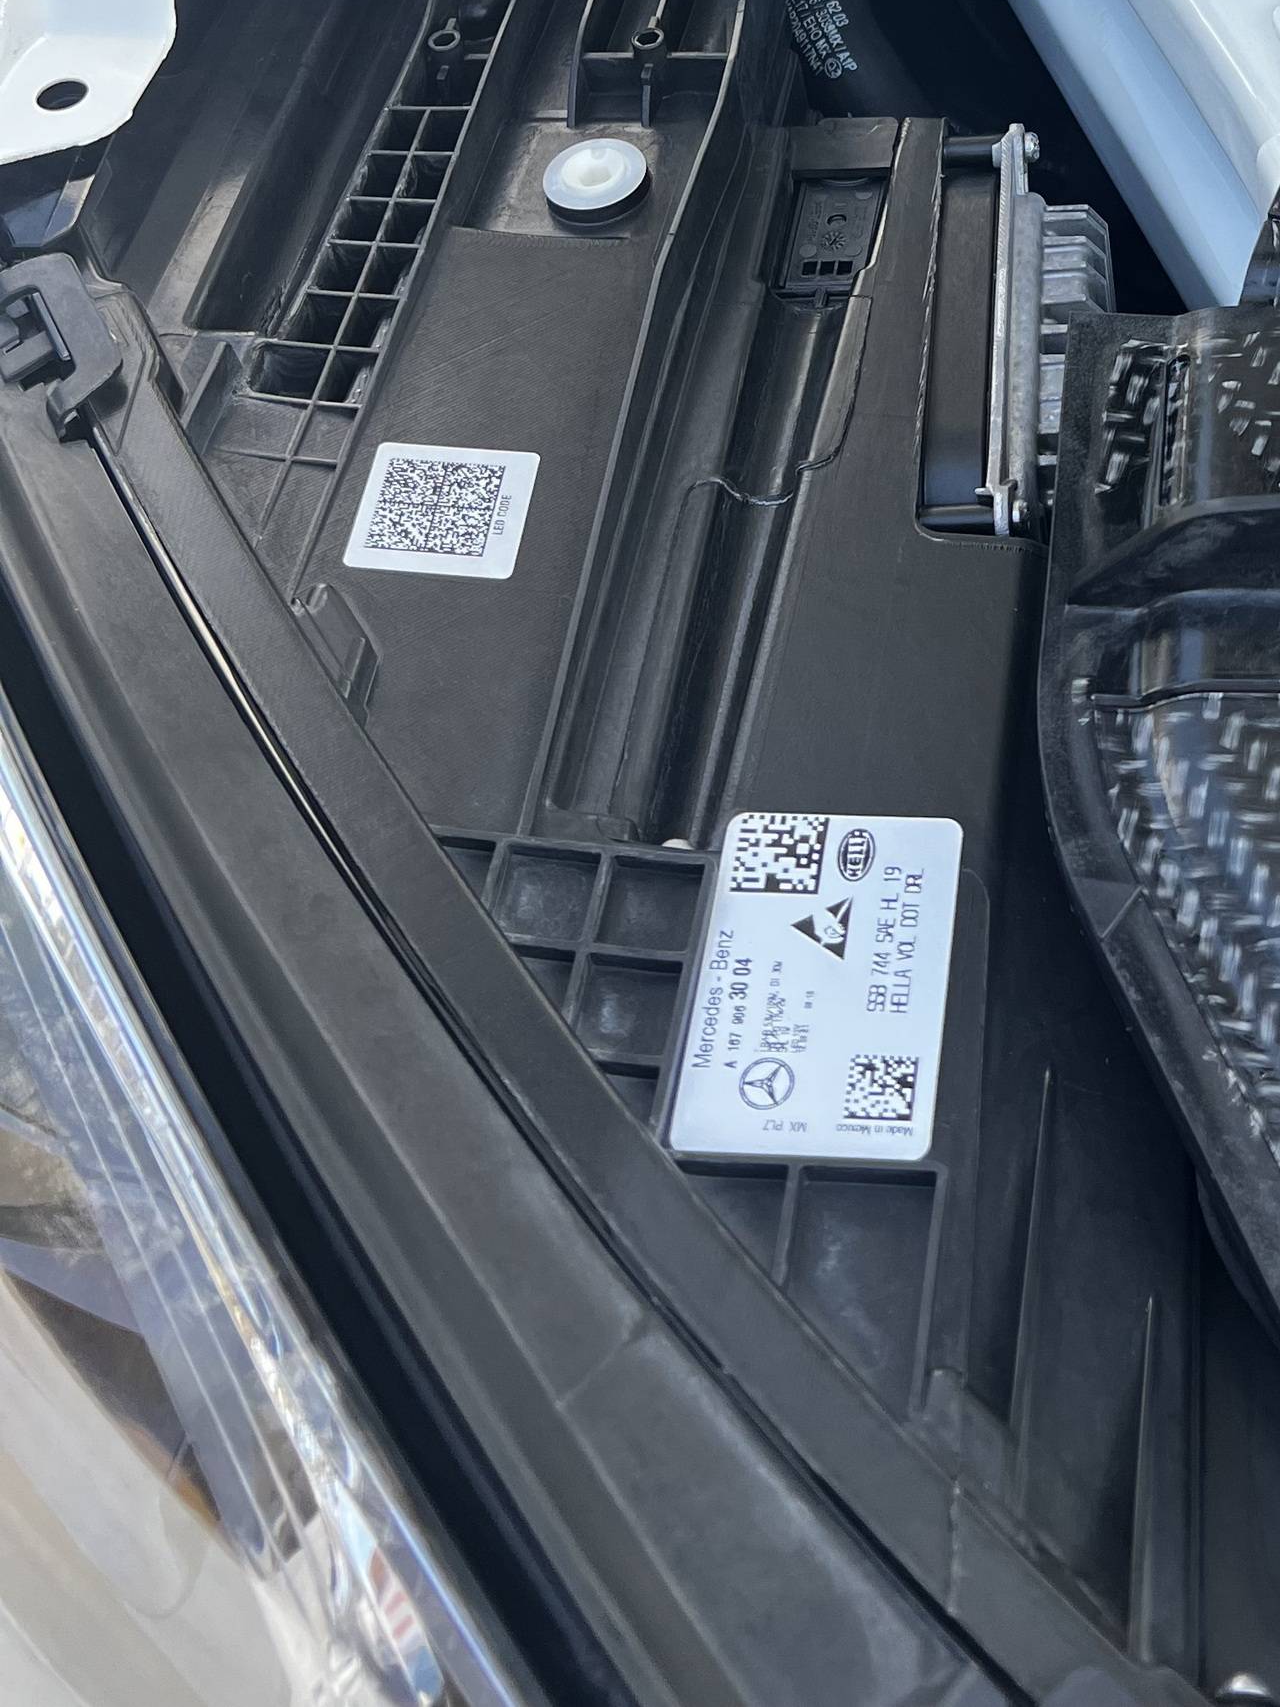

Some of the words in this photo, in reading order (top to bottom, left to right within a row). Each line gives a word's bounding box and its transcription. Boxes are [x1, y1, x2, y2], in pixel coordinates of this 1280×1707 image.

[826, 0, 842, 15] 62
[833, 14, 849, 27] 03
[496, 495, 512, 517] CODE
[491, 520, 505, 535] LED
[846, 829, 869, 878] HELLA
[883, 866, 902, 882] 19
[904, 868, 924, 894] DRL
[880, 894, 899, 910] HL
[900, 902, 920, 928] DOT
[875, 918, 895, 943] SAE
[894, 937, 916, 960] VOL
[733, 958, 752, 976] 04
[871, 952, 890, 975] 744
[691, 987, 724, 1068] Mercedes
[709, 930, 734, 970] Benz
[728, 982, 748, 1000] 30
[890, 968, 912, 1013] HELLA
[732, 1005, 746, 1024] 906
[728, 1033, 742, 1051] 167
[724, 1061, 738, 1069] A
[789, 1122, 808, 1133] MX
[836, 1123, 872, 1135] Mexico
[875, 1124, 884, 1133] in
[886, 1124, 914, 1136] Made
